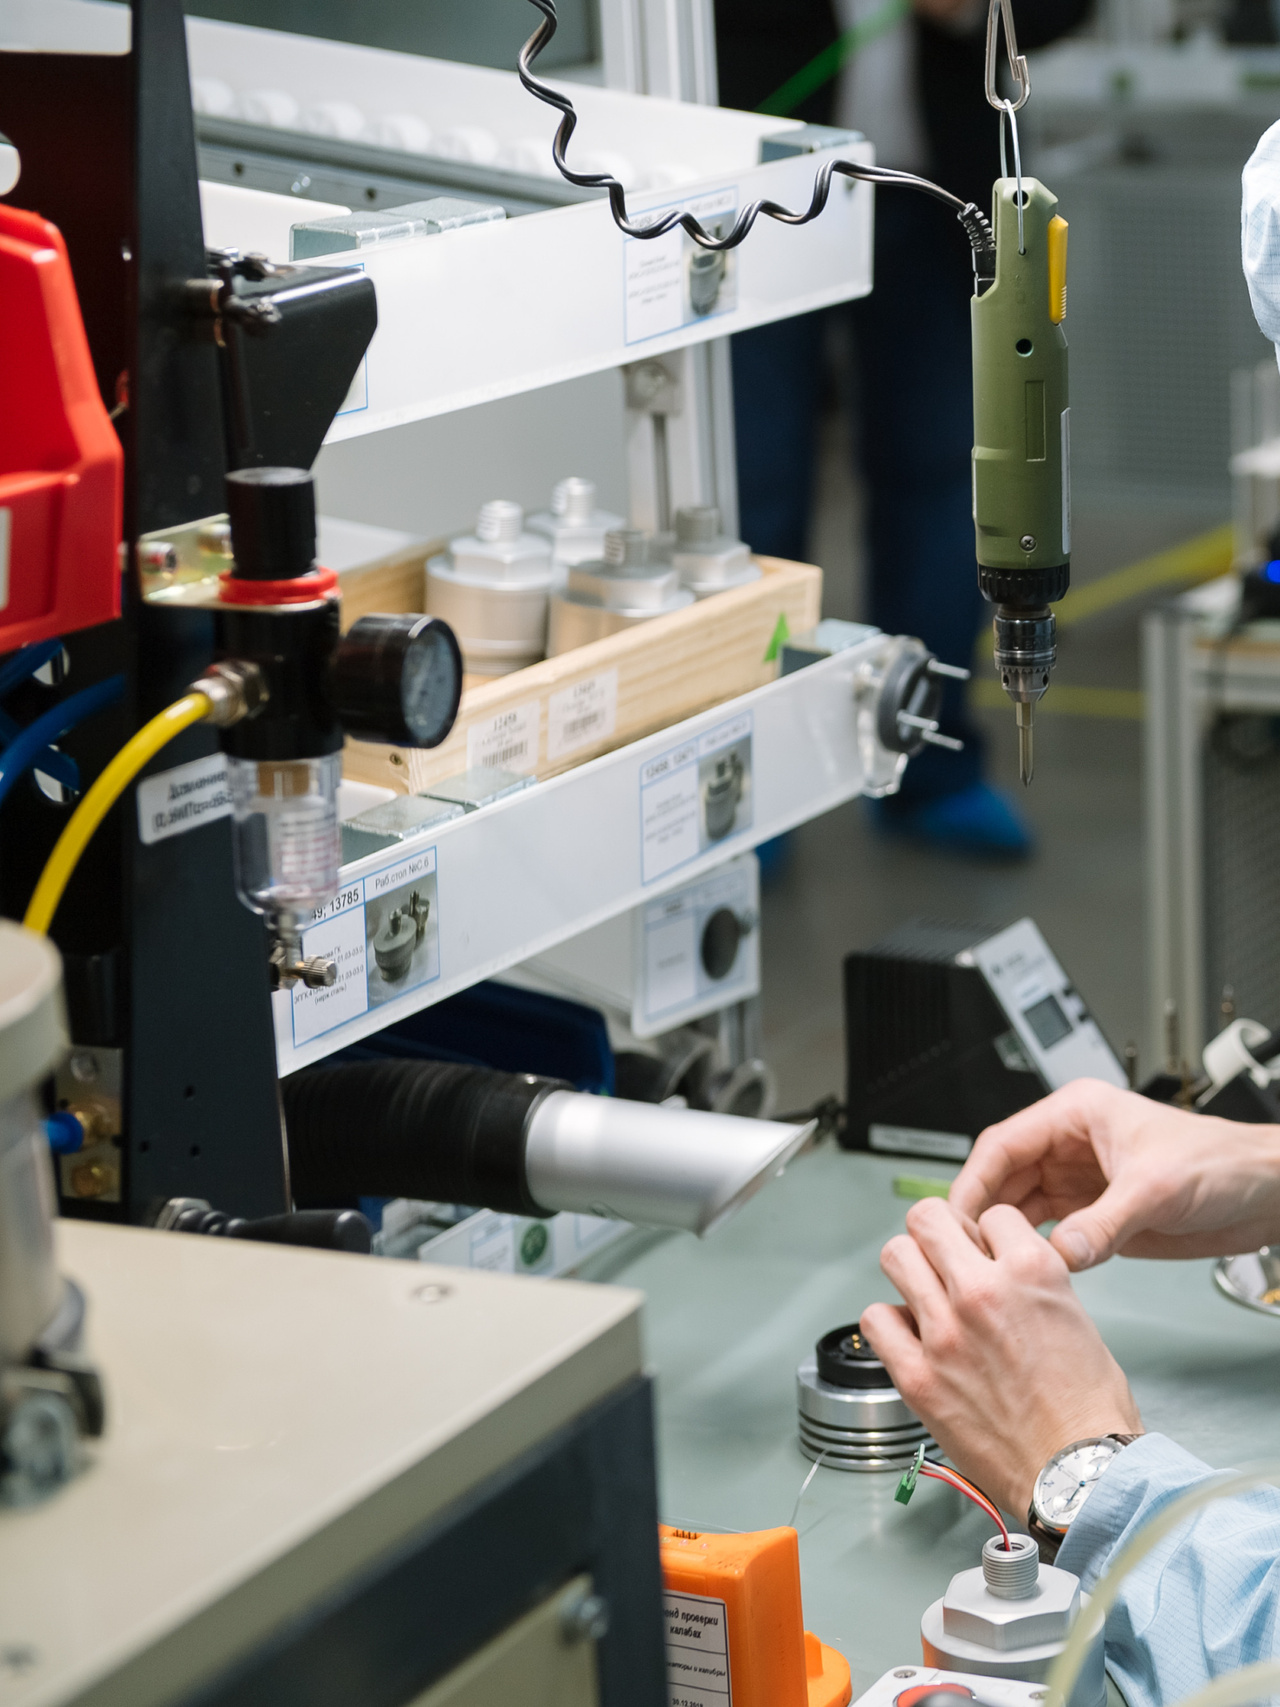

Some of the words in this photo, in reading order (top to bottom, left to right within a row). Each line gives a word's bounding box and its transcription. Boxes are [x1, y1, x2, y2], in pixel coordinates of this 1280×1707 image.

[375, 870, 408, 890] Раб.стол
[330, 887, 360, 914] 13785
[664, 1607, 680, 1619] енд
[681, 1611, 719, 1627] проверки
[698, 1666, 727, 1678] калибры
